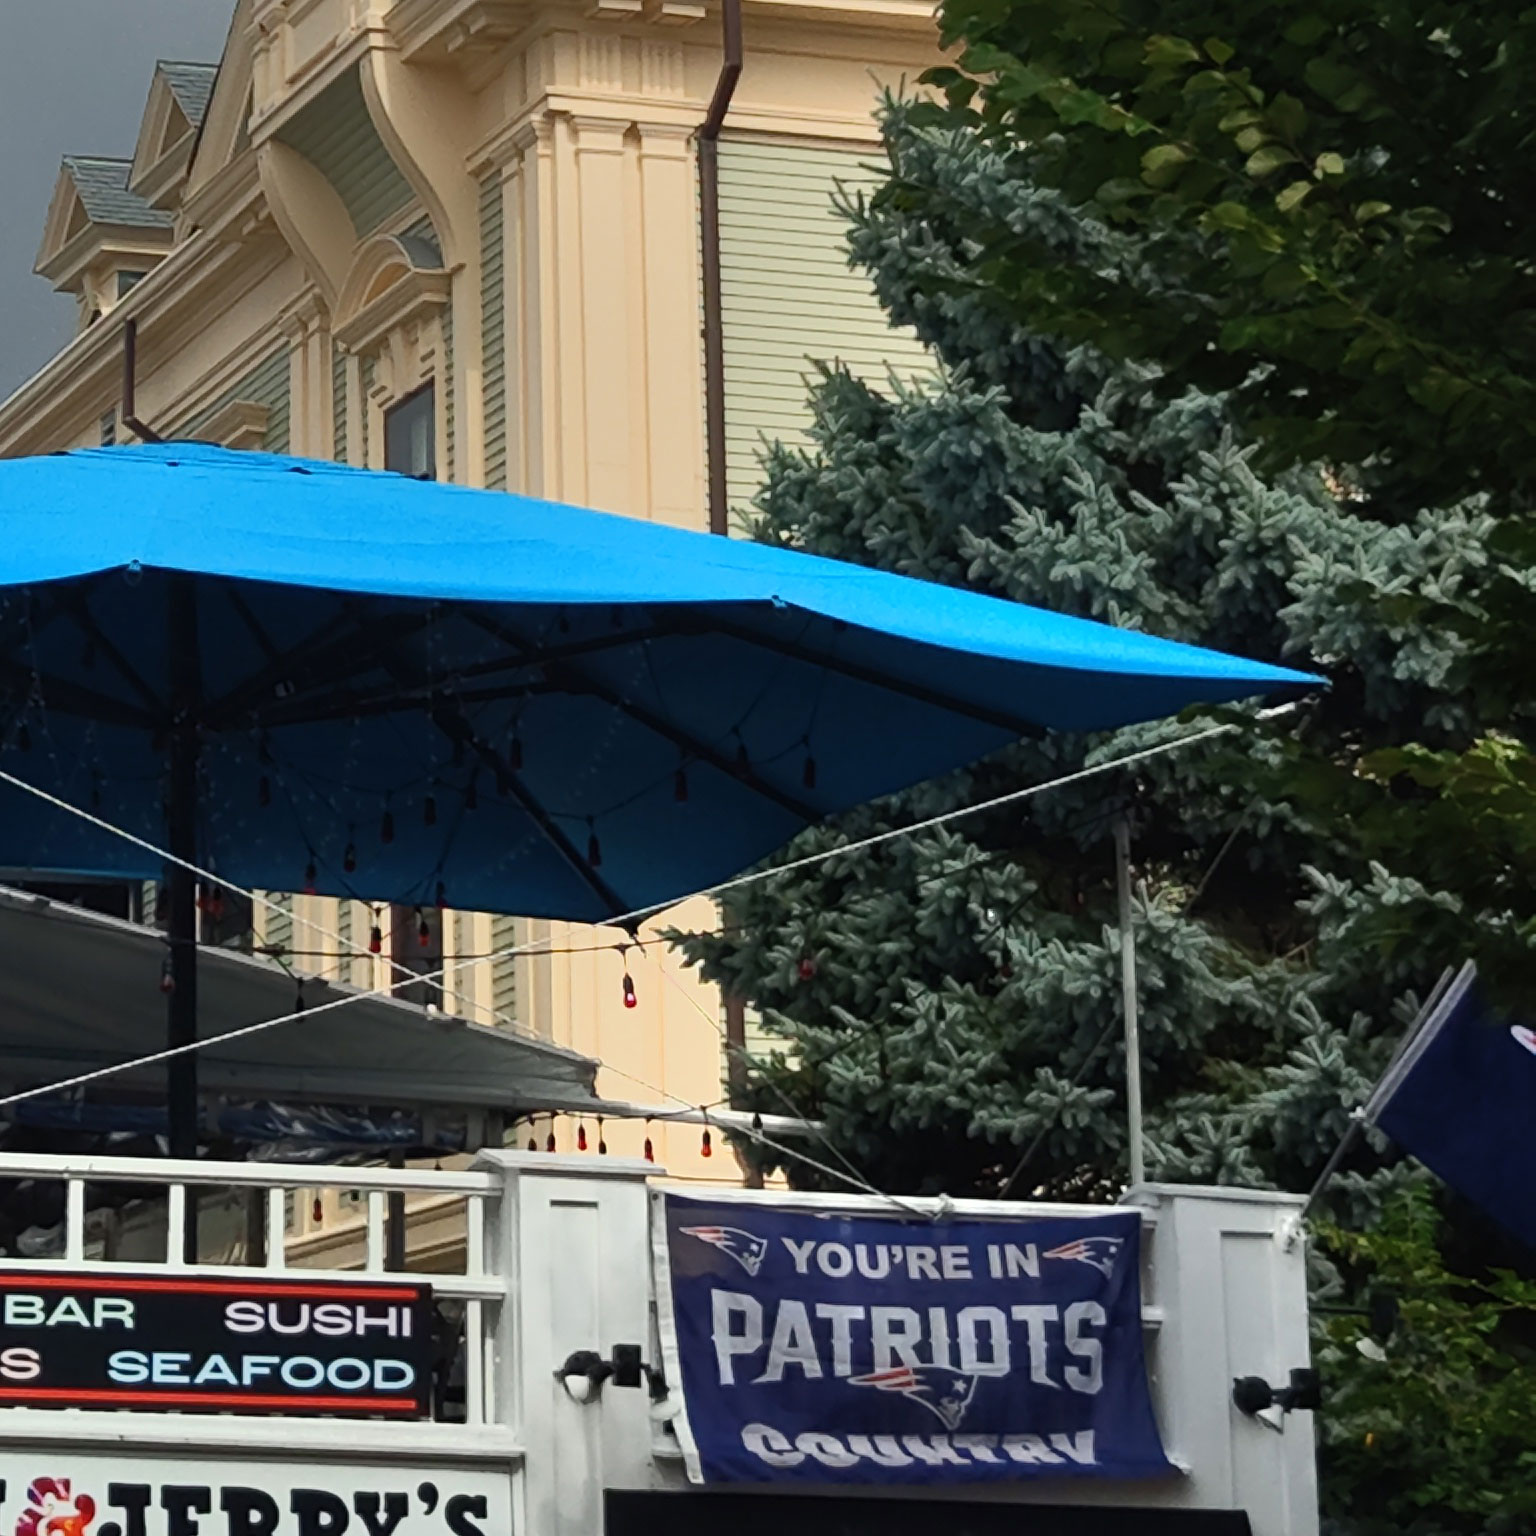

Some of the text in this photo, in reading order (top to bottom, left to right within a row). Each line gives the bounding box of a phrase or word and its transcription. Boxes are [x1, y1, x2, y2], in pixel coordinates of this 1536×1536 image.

[781, 1237, 1041, 1280] YOU'RE IN
[4, 1295, 134, 1328] BAR
[225, 1302, 413, 1337] SUSHI
[711, 1288, 1107, 1395] PATRIOTS
[108, 1350, 415, 1390] SEAFOOD
